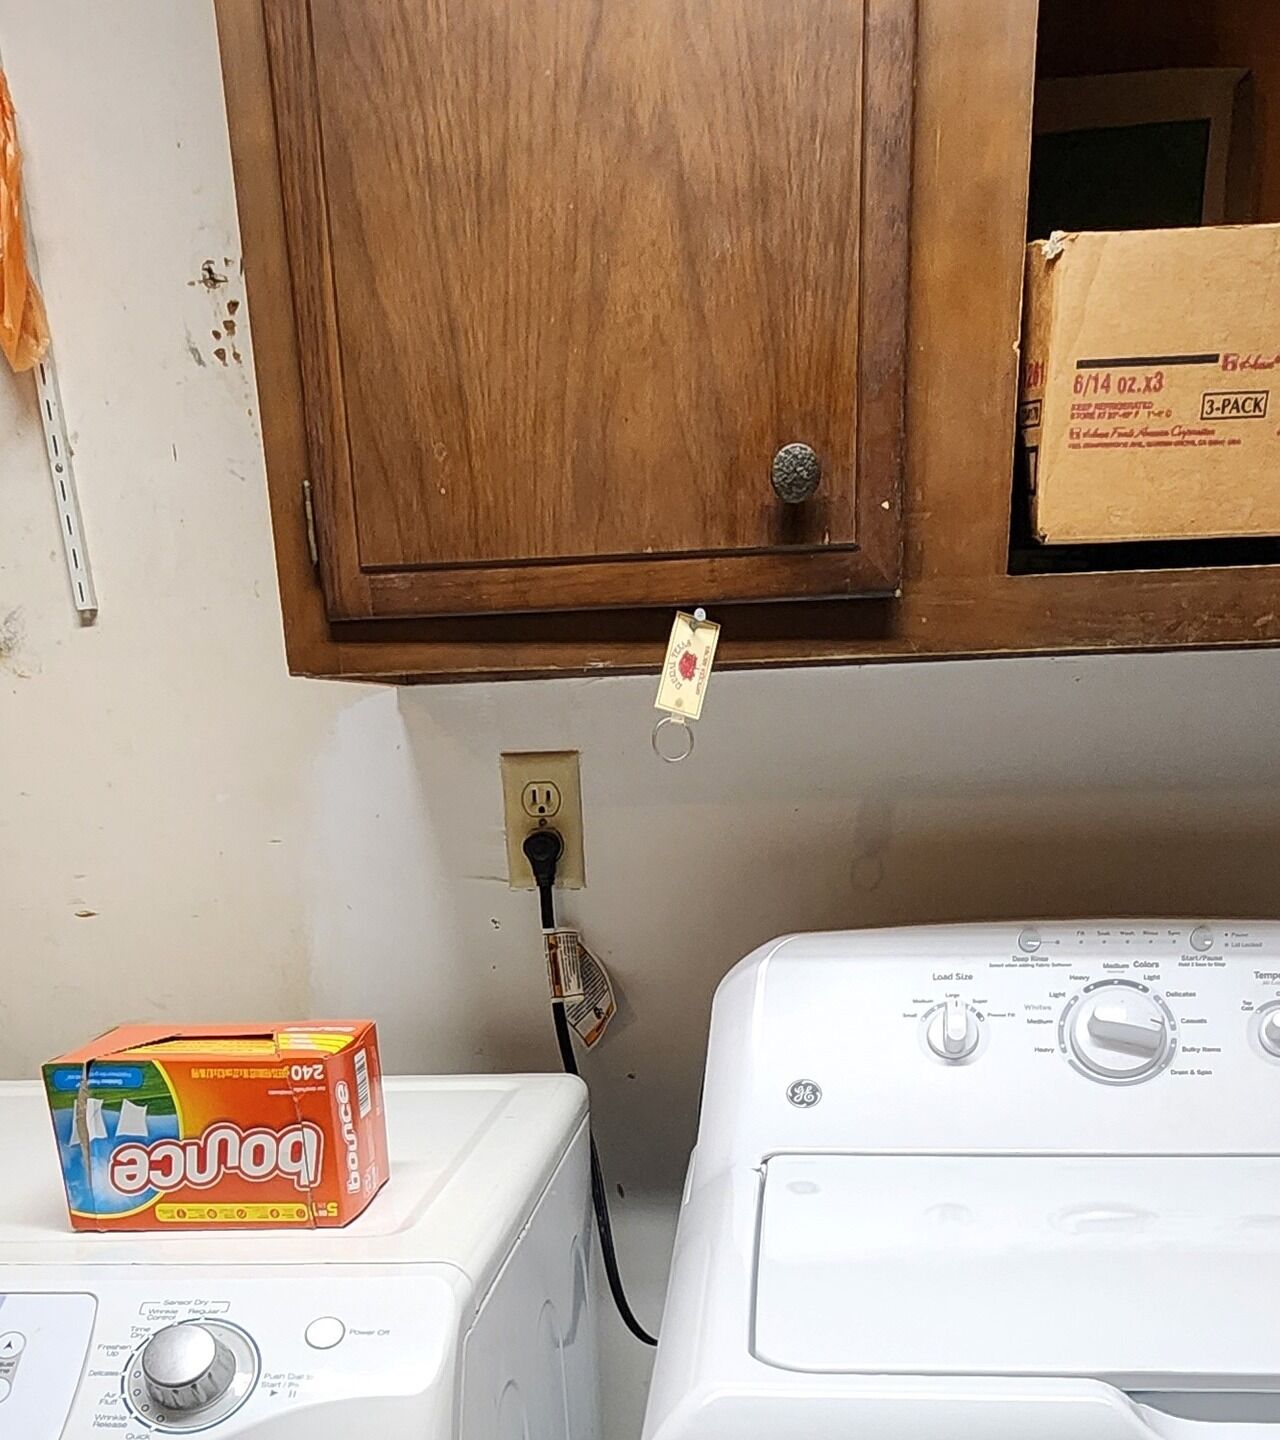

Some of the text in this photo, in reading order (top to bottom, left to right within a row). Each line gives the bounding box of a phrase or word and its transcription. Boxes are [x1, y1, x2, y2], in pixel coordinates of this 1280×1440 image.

[1073, 374, 1111, 397] 6/14
[1205, 397, 1264, 415] 3-PACK
[1133, 960, 1159, 969] Colors
[932, 973, 973, 981] Load Size
[1034, 1046, 1054, 1054] Heavy
[291, 1064, 324, 1081] 240
[336, 1081, 361, 1194] bounce
[109, 1122, 325, 1195] bounce
[325, 1201, 338, 1216] 5
[104, 1391, 116, 1399] Air
[92, 1420, 128, 1428] Release
[125, 1432, 150, 1440] Quick
